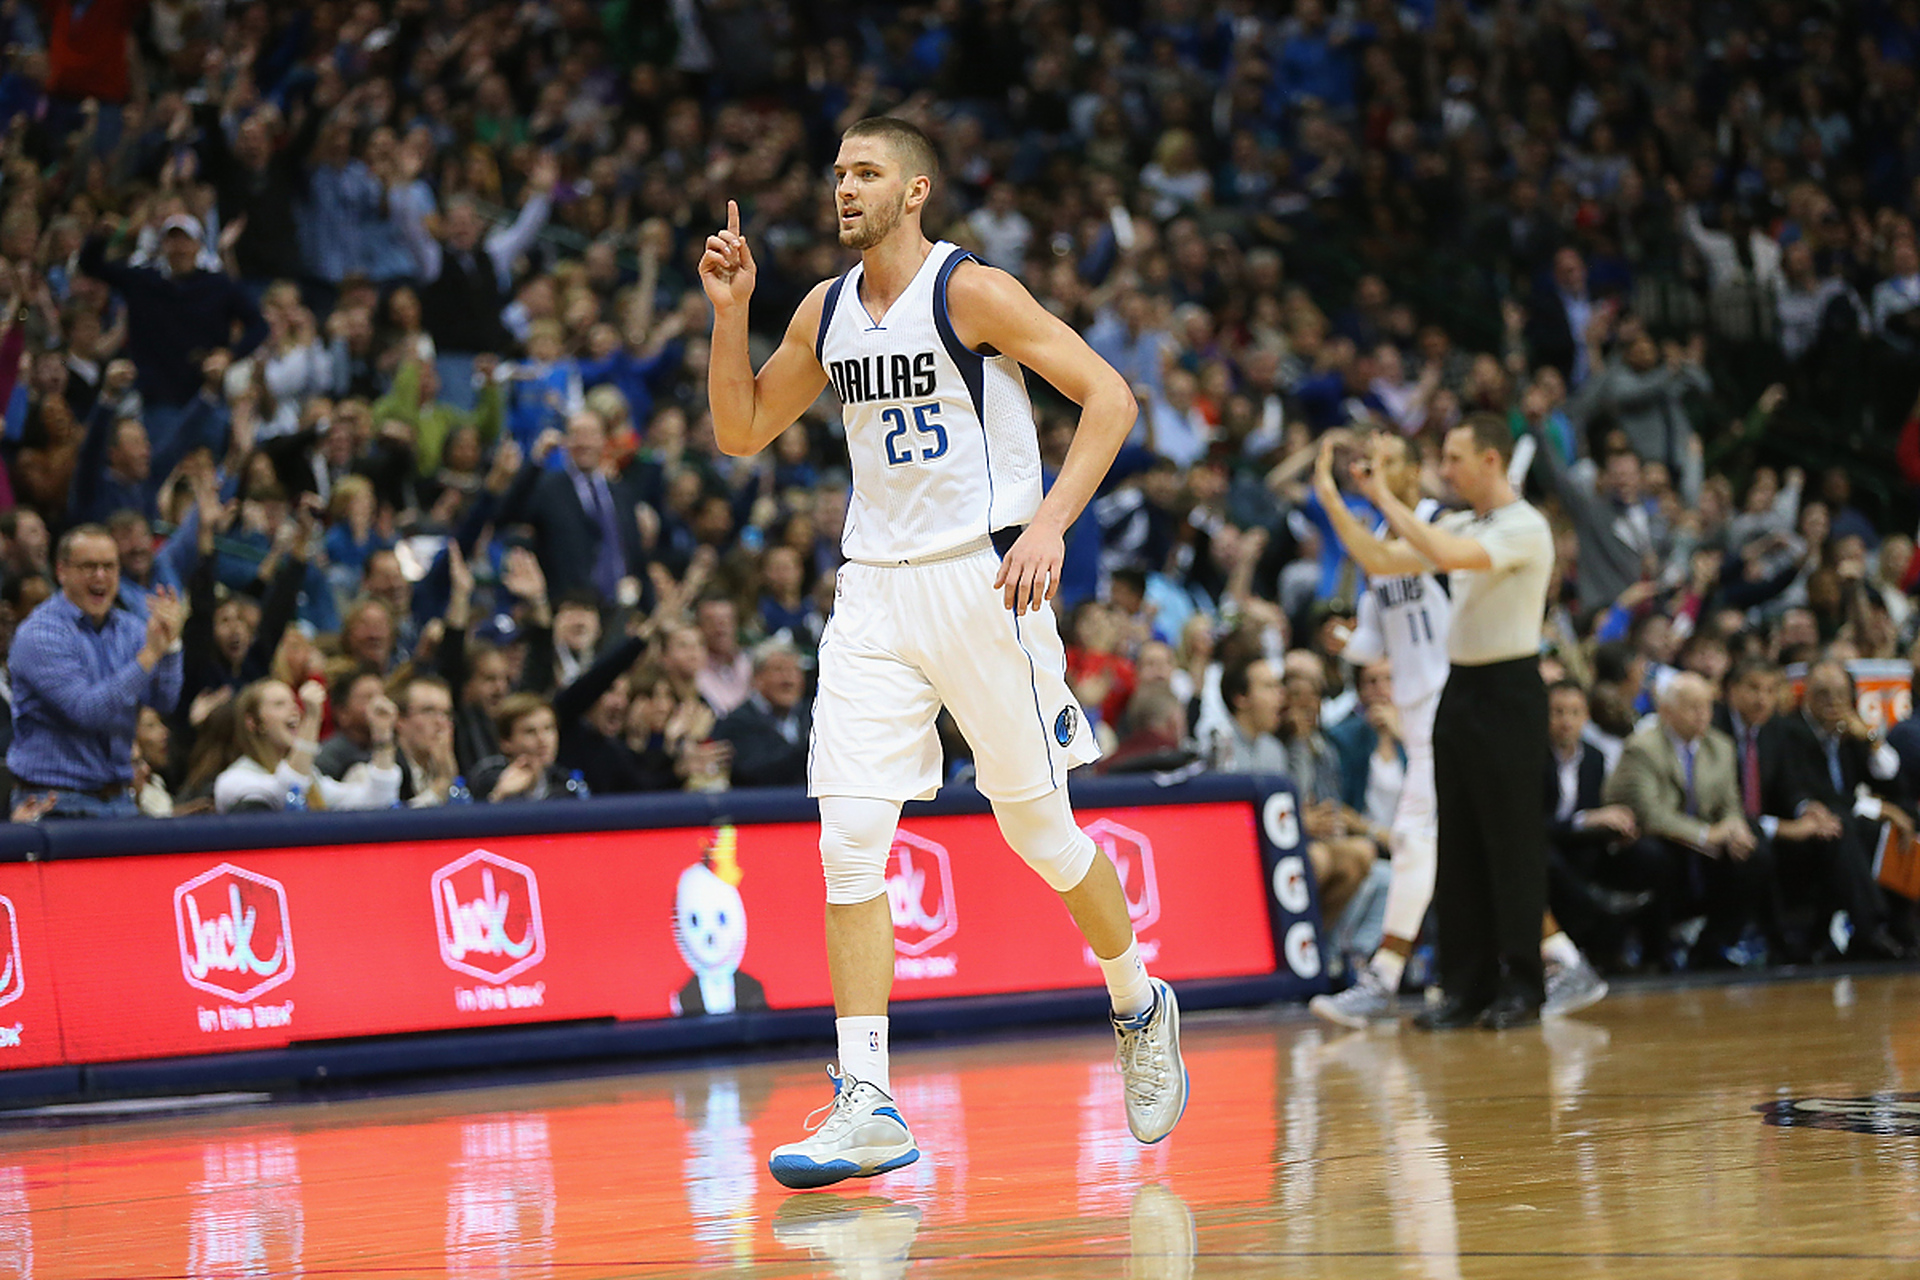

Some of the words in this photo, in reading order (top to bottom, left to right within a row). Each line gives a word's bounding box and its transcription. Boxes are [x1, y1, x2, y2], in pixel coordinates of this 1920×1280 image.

[829, 352, 937, 404] DALLAS
[880, 402, 950, 467] 25
[1407, 609, 1432, 642] 11
[1263, 791, 1300, 850] G
[442, 867, 536, 960] Jack
[1272, 855, 1310, 914] G
[185, 882, 285, 979] Jack
[1284, 920, 1321, 979] G
